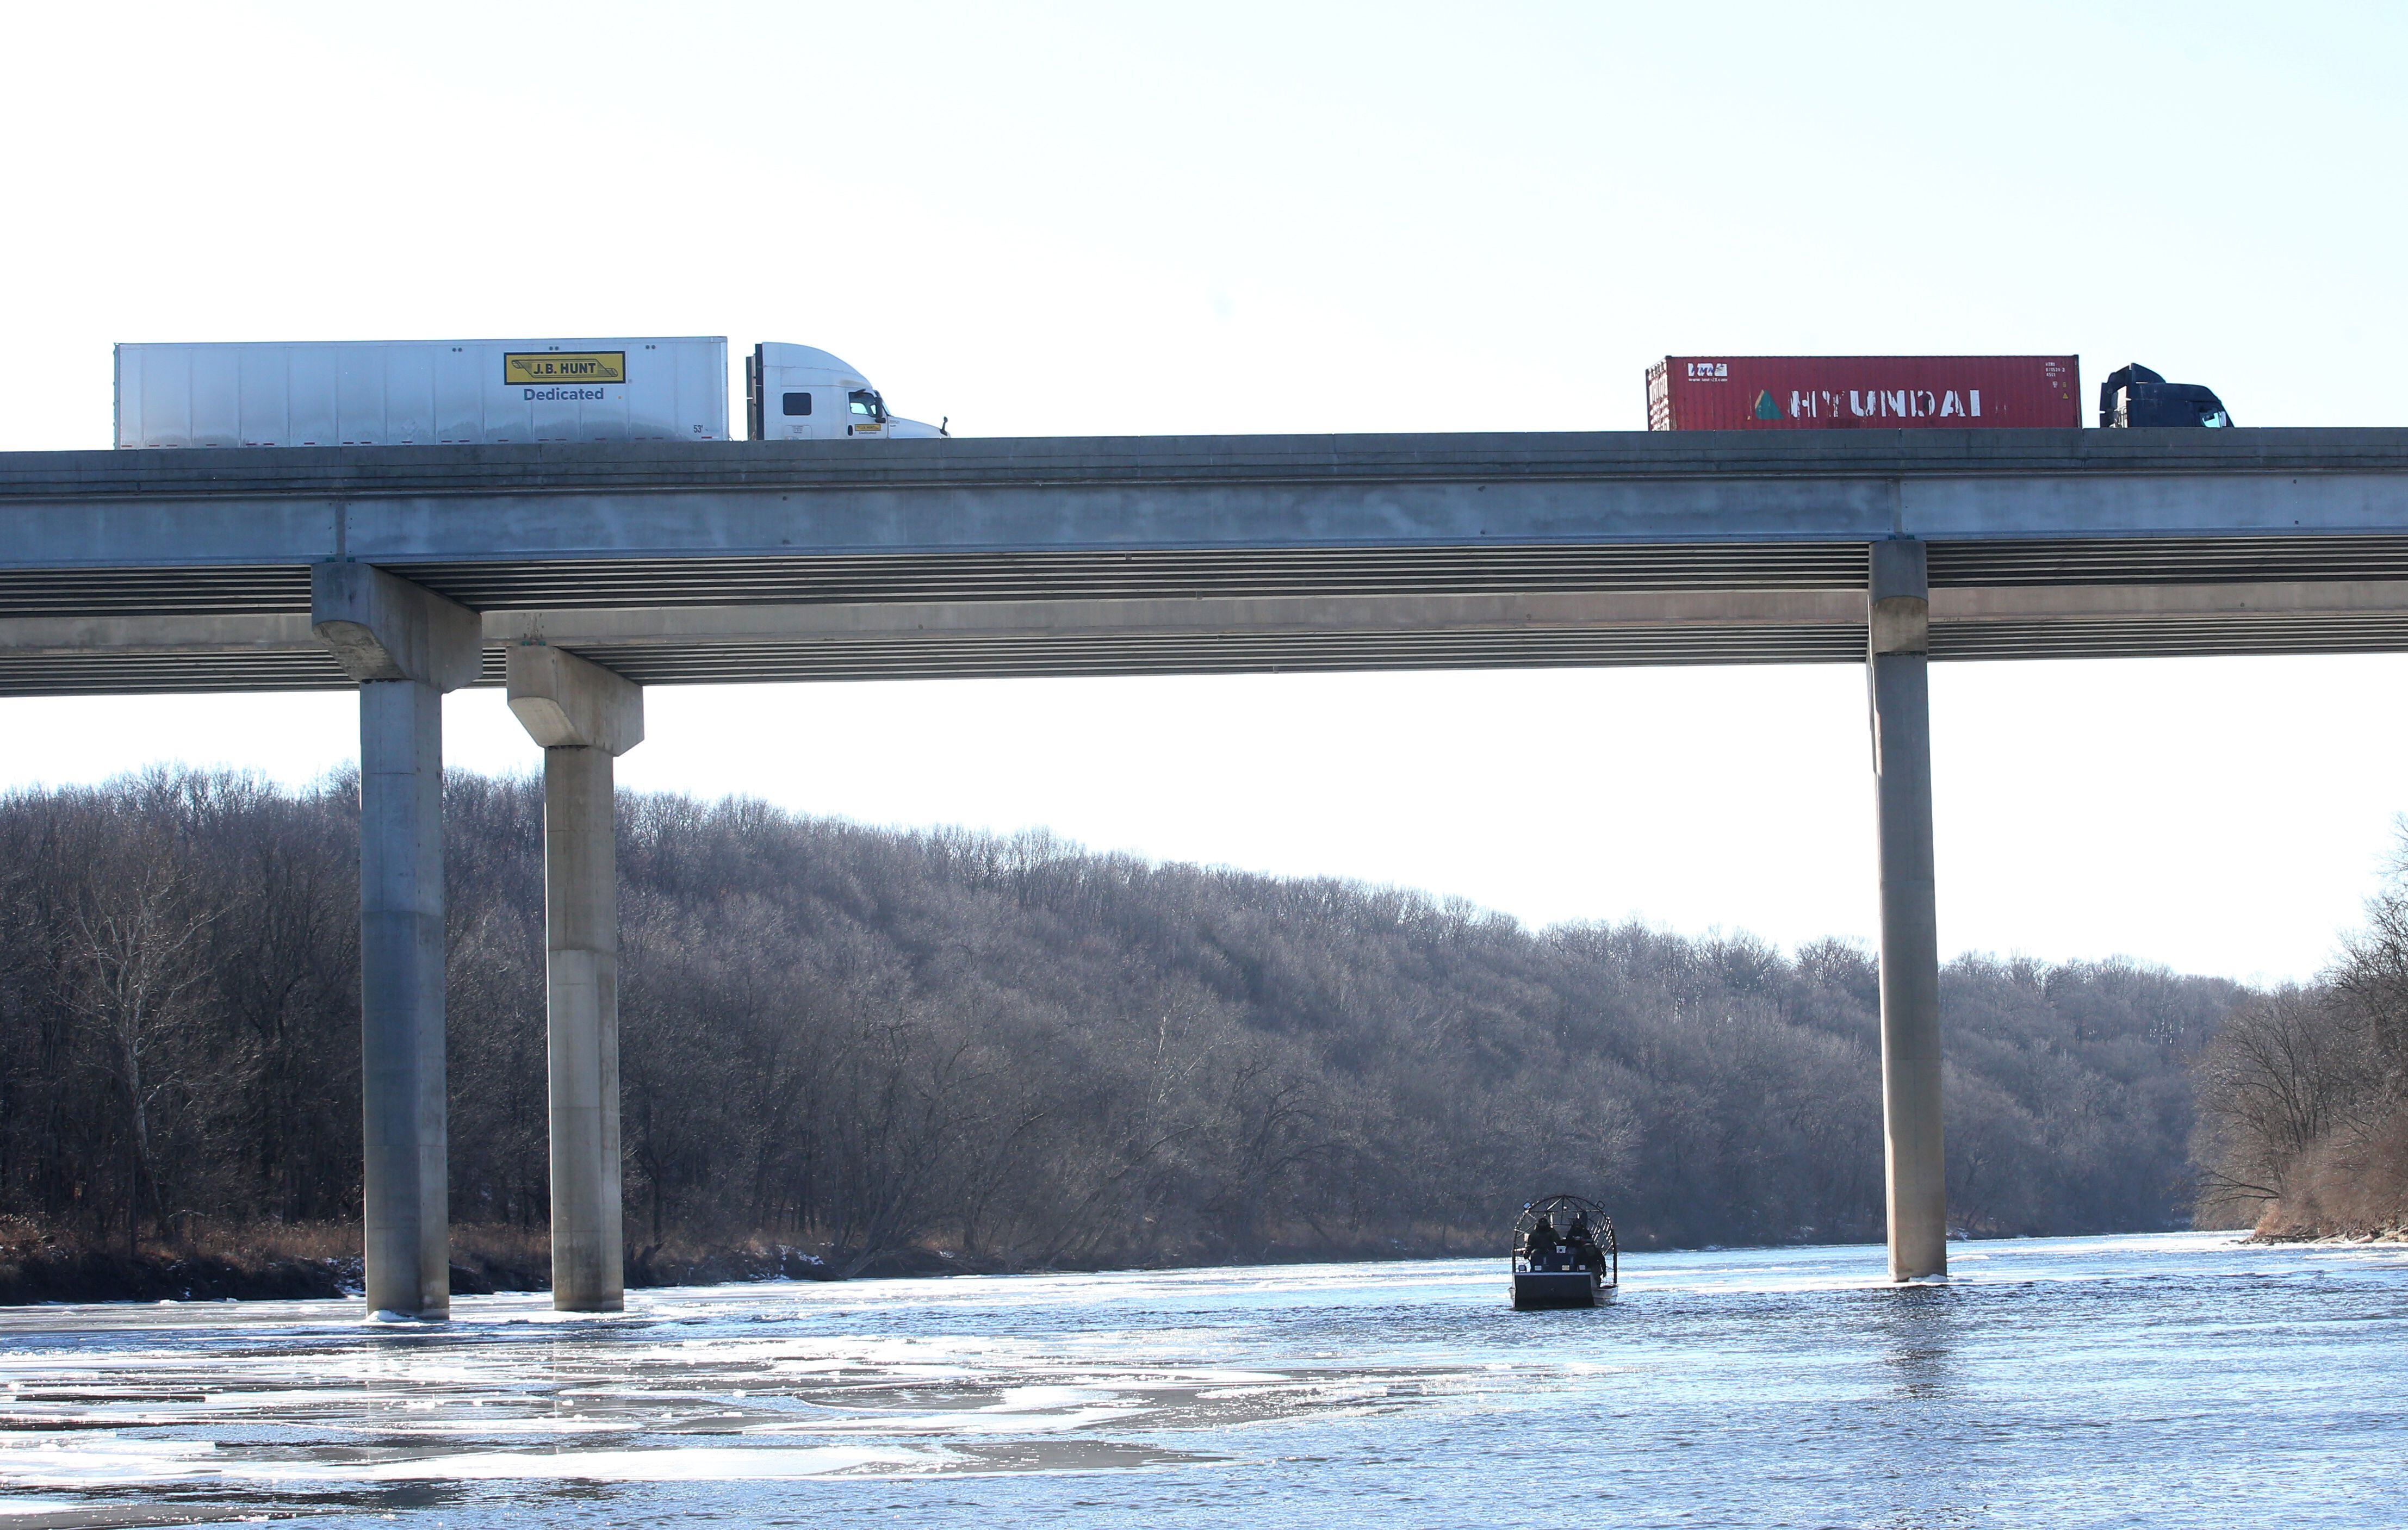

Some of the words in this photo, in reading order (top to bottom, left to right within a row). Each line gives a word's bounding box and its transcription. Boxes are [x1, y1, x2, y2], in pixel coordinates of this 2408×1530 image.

[561, 363, 596, 374] HUNT
[524, 387, 604, 401] Dedicated
[1789, 390, 1981, 418] HYUNDAI
